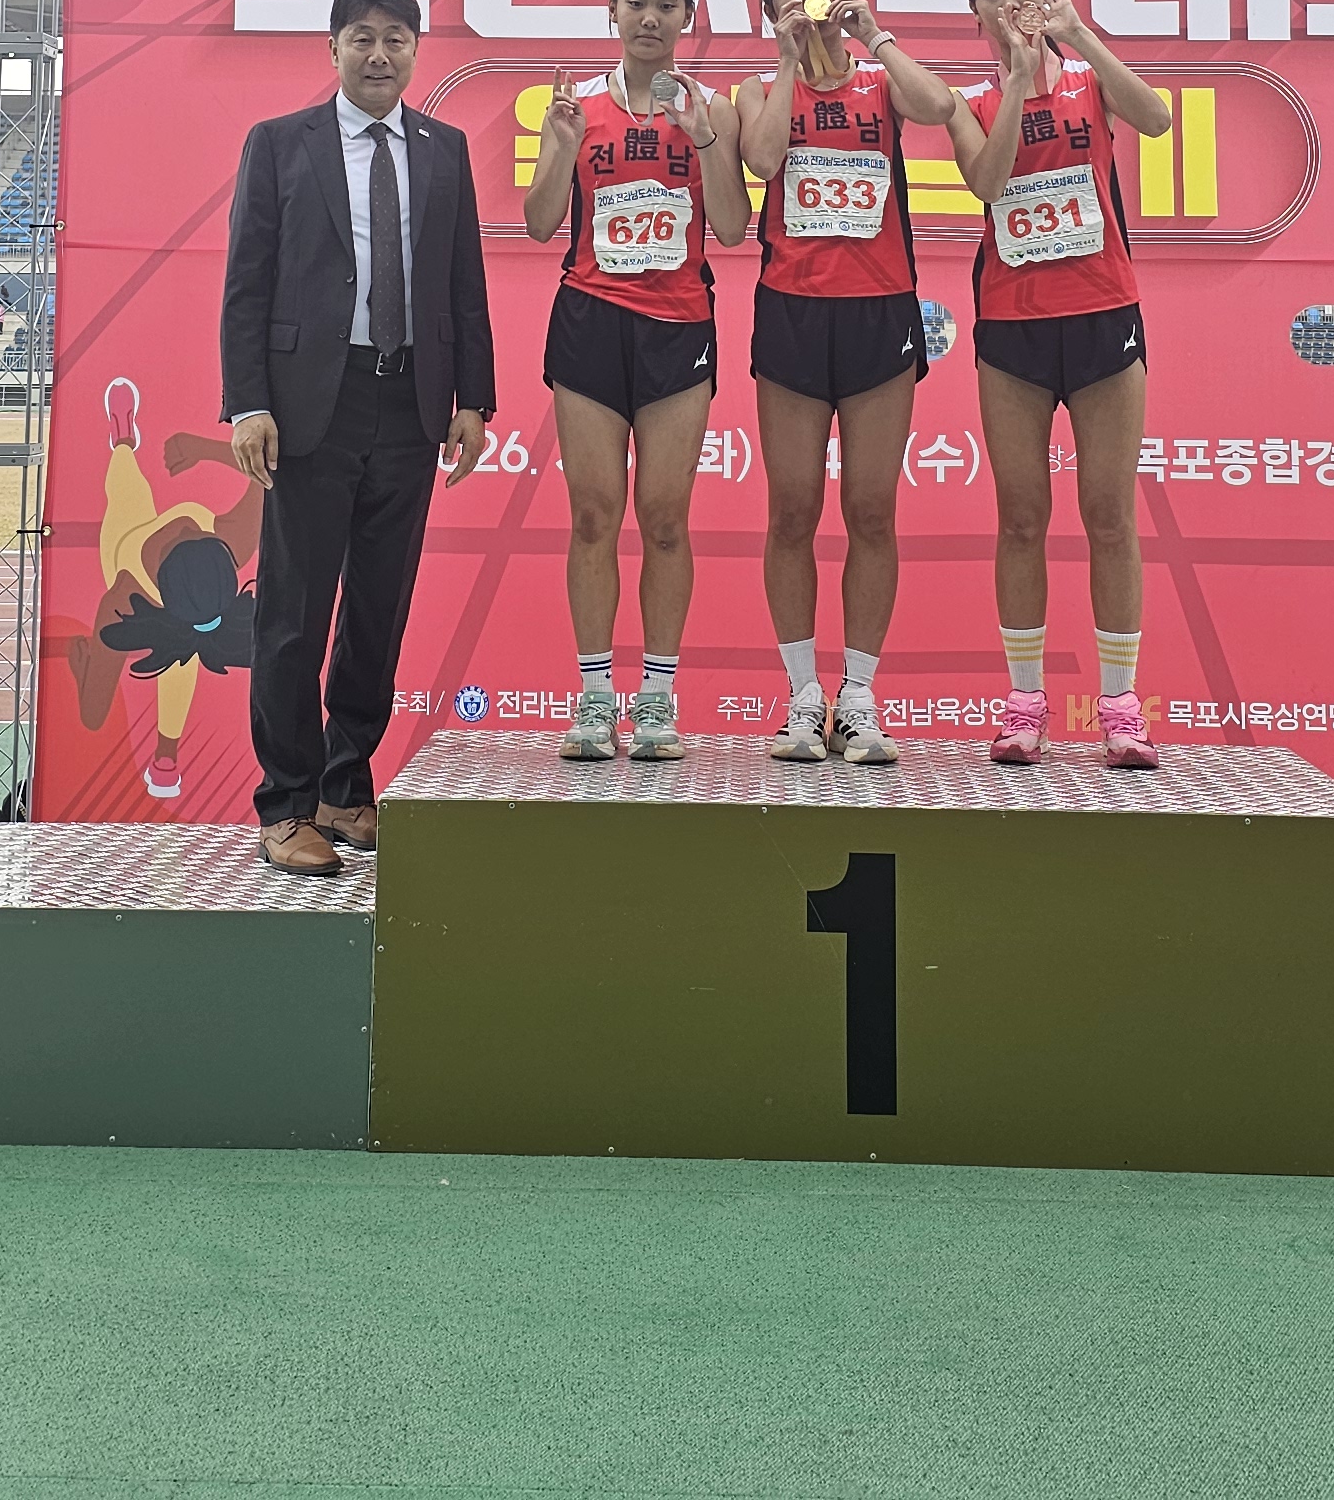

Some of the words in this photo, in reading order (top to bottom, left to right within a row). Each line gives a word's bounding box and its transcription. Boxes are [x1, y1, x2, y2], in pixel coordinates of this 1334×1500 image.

[789, 155, 809, 166] 2026
[797, 177, 877, 209] 633
[607, 210, 677, 245] 626
[1007, 197, 1084, 239] 631
[716, 696, 765, 721] 주관
[882, 697, 1008, 727] 전남육상연
[806, 852, 897, 1116] 1
